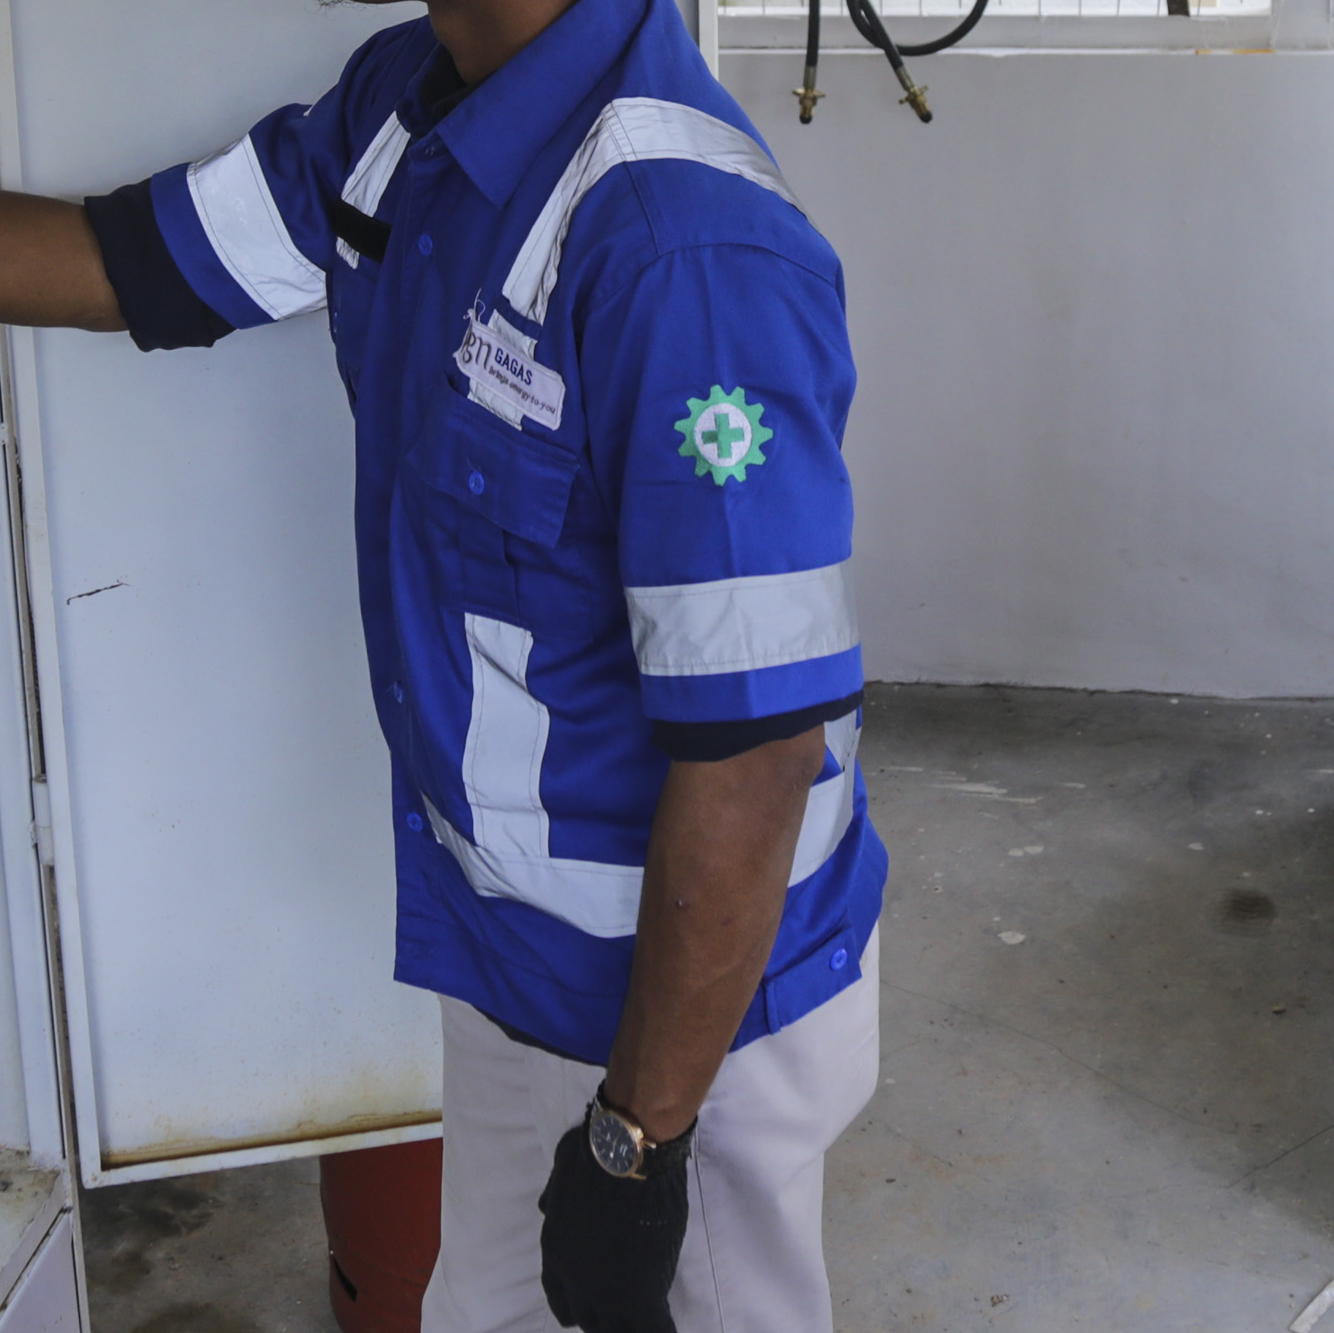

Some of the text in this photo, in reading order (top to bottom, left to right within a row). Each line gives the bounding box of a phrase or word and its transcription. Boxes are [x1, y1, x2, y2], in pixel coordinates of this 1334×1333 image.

[495, 347, 533, 386] GAGAS
[488, 366, 509, 384] brings
[509, 382, 529, 401] energy
[540, 402, 556, 414] you
